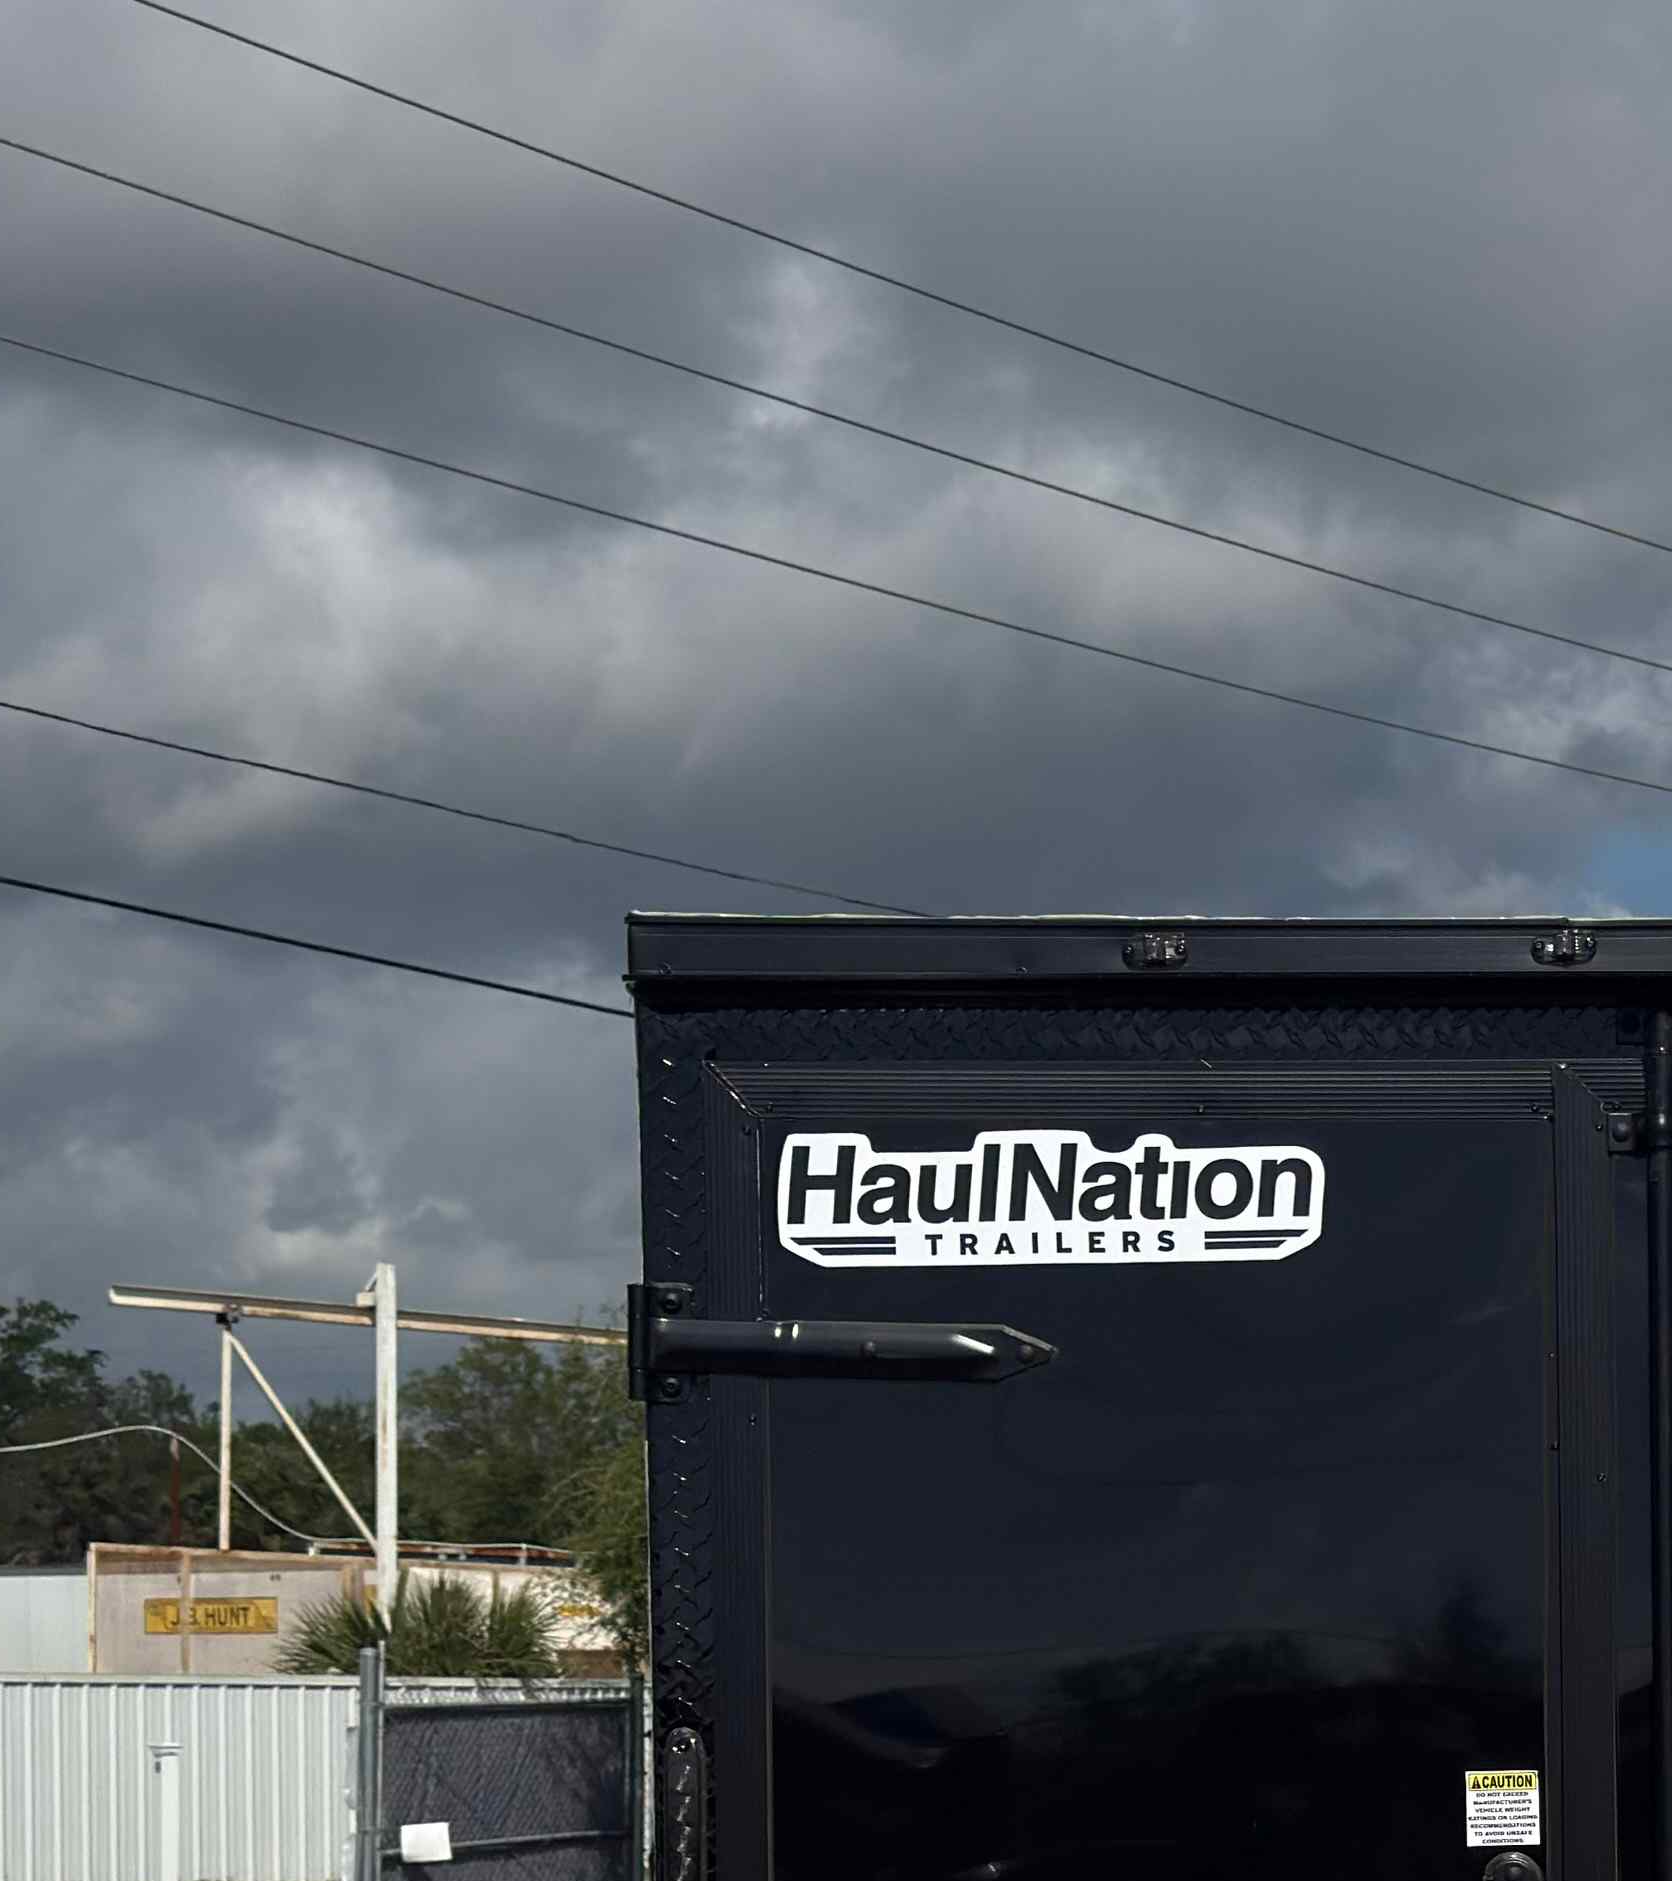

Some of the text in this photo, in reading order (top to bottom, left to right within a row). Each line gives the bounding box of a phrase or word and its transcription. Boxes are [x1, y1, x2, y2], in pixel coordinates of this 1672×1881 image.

[786, 1142, 1314, 1225] HaulNation
[924, 1229, 1176, 1257] TRAILERS
[204, 1606, 250, 1627] HUNT
[1482, 1775, 1533, 1788] CAUTION
